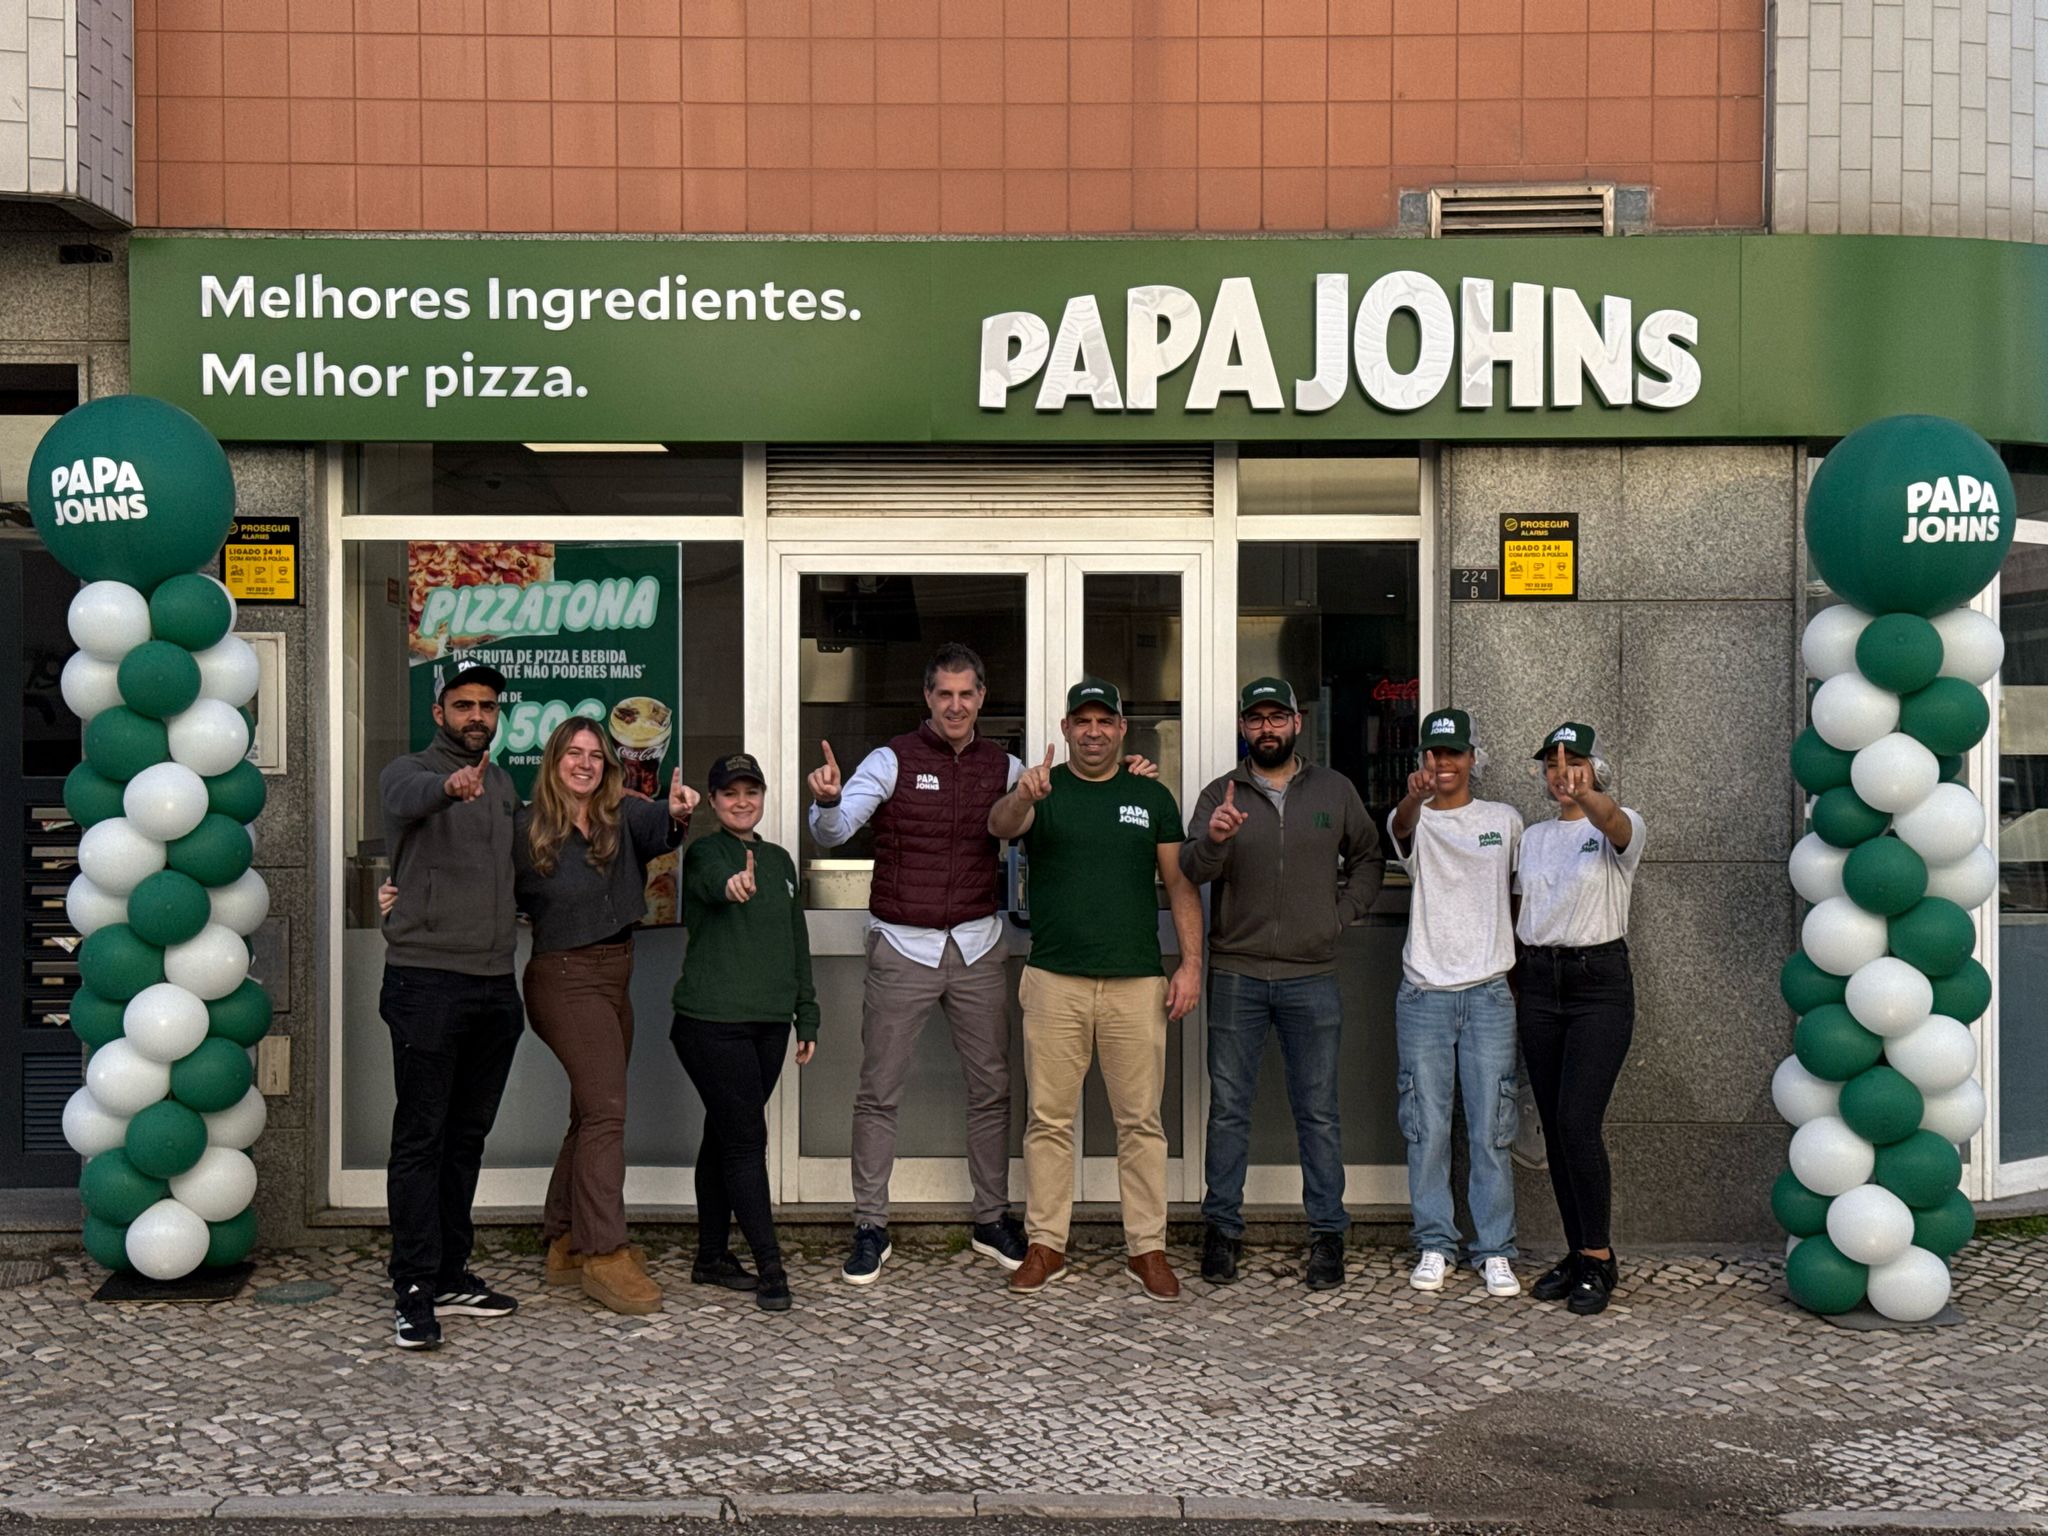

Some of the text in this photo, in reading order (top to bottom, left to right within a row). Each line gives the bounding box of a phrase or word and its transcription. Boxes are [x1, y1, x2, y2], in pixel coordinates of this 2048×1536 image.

[201, 273, 862, 331] Melhores Ingredientes.
[979, 270, 1703, 412] PAPA JOHNS
[202, 351, 589, 408] Melhor pizza.
[51, 456, 144, 497] PAPA
[1907, 475, 2000, 513] PAPA
[54, 493, 149, 526] JOHNS
[241, 524, 290, 532] PROSEGUR
[1520, 520, 1570, 528] PROSEGUR
[1903, 514, 2000, 543] JOHNS
[1462, 570, 1488, 583] 224
[1471, 586, 1479, 599] B
[420, 577, 659, 637] PIZZATONA
[517, 650, 532, 663] DE
[535, 650, 570, 664] PIZZA
[573, 650, 579, 663] E
[582, 650, 627, 663] BEBIDA
[524, 661, 550, 679] NÃO
[552, 664, 608, 679] PODERES
[509, 691, 522, 702] DE
[509, 755, 525, 765] POR
[917, 773, 939, 784] PAPA
[1119, 805, 1149, 819] PAPA
[1119, 814, 1149, 828] JOHNS
[1479, 831, 1502, 841] PAPA
